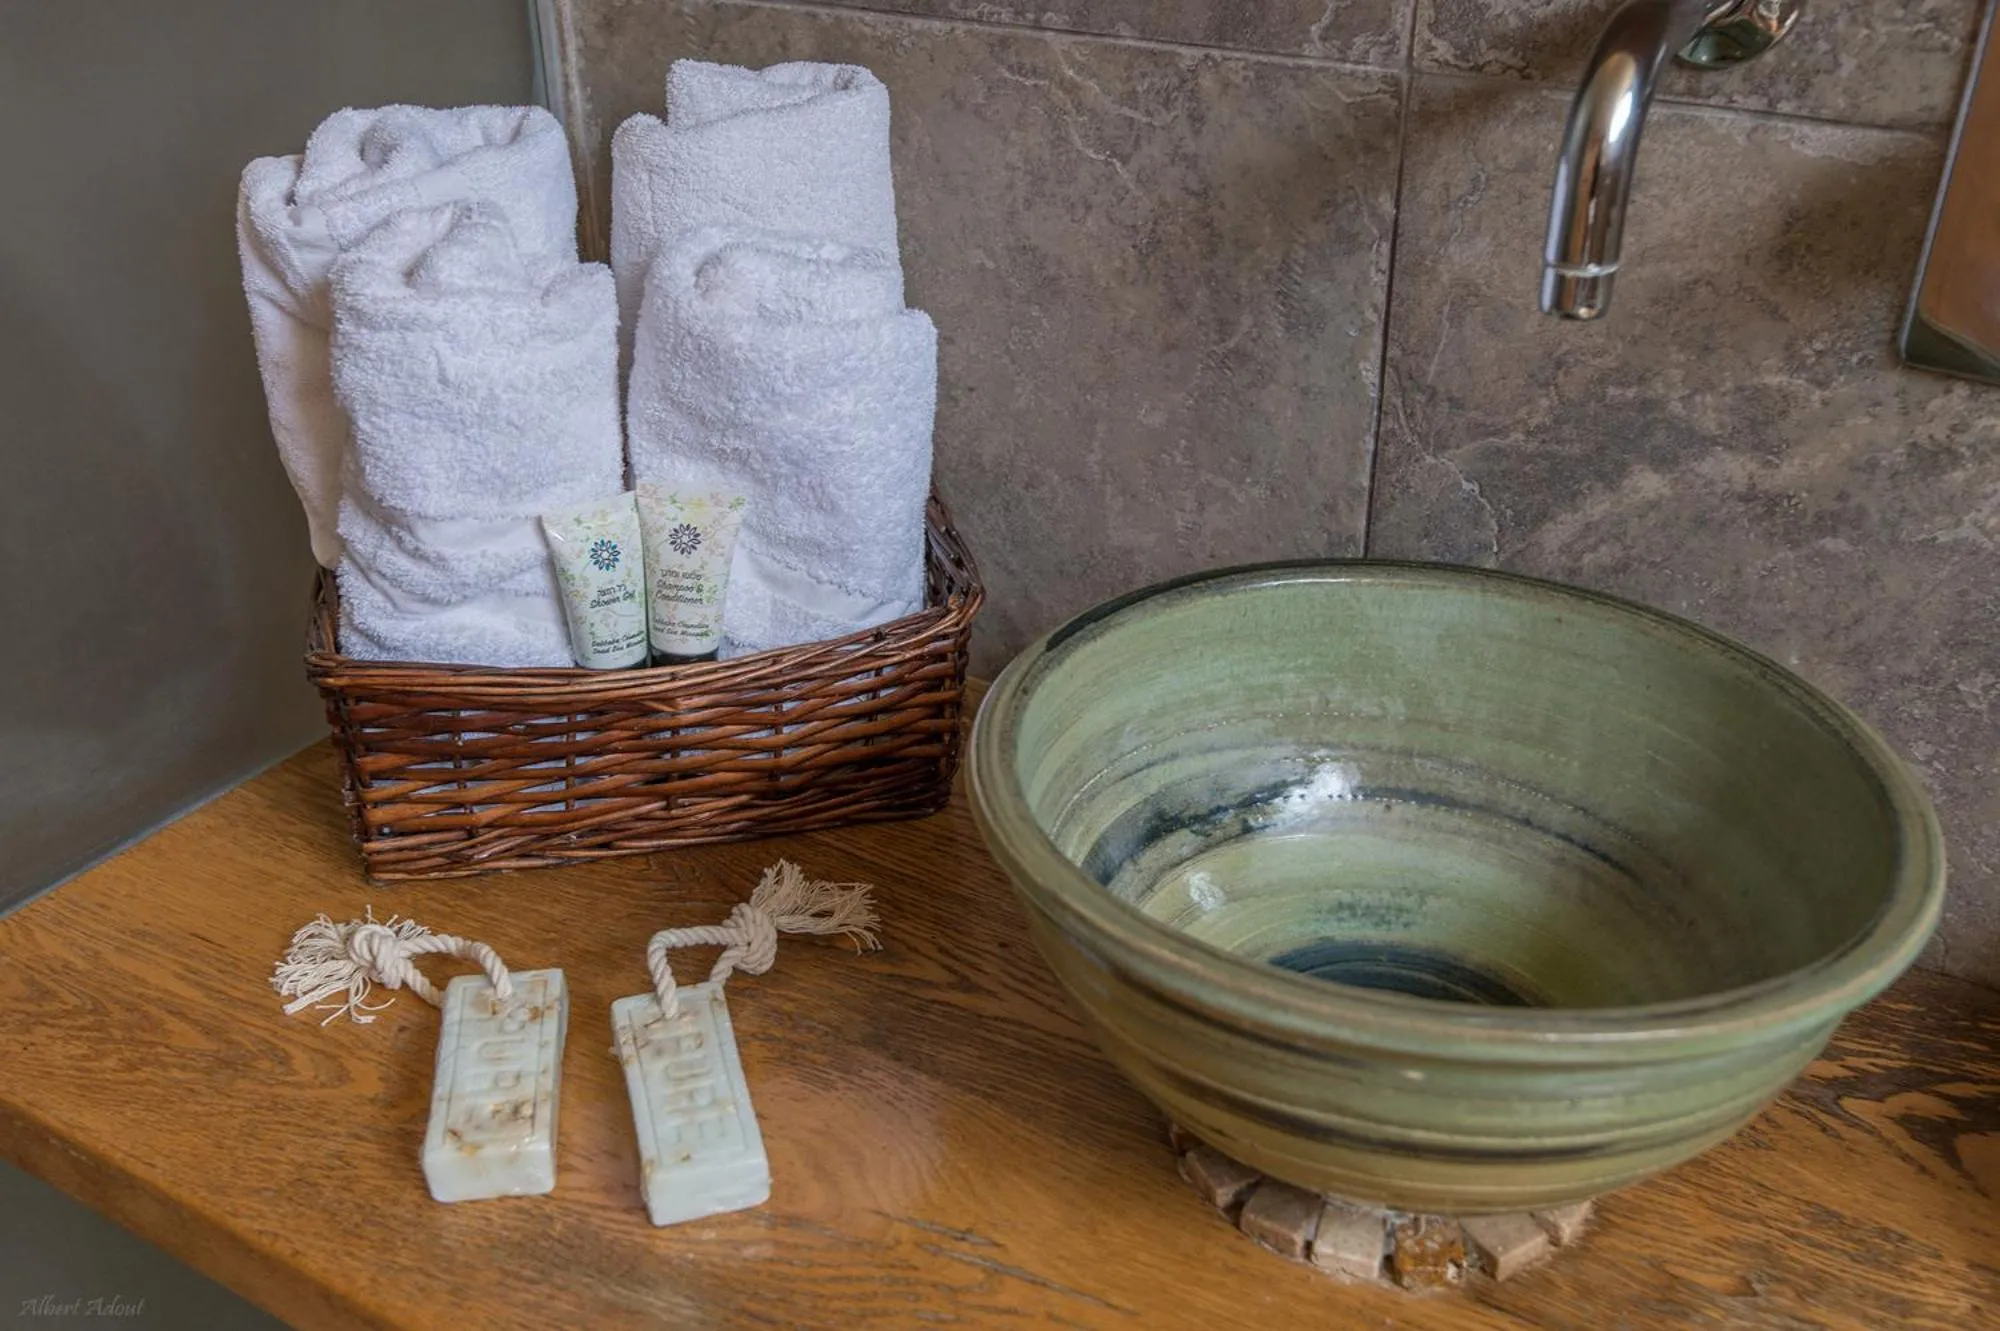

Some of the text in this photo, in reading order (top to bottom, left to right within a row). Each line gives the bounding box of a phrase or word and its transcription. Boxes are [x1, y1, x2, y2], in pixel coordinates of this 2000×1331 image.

[657, 578, 695, 595] Shampoo
[590, 589, 636, 608] Shower Gel
[656, 590, 704, 605] Conditioner
